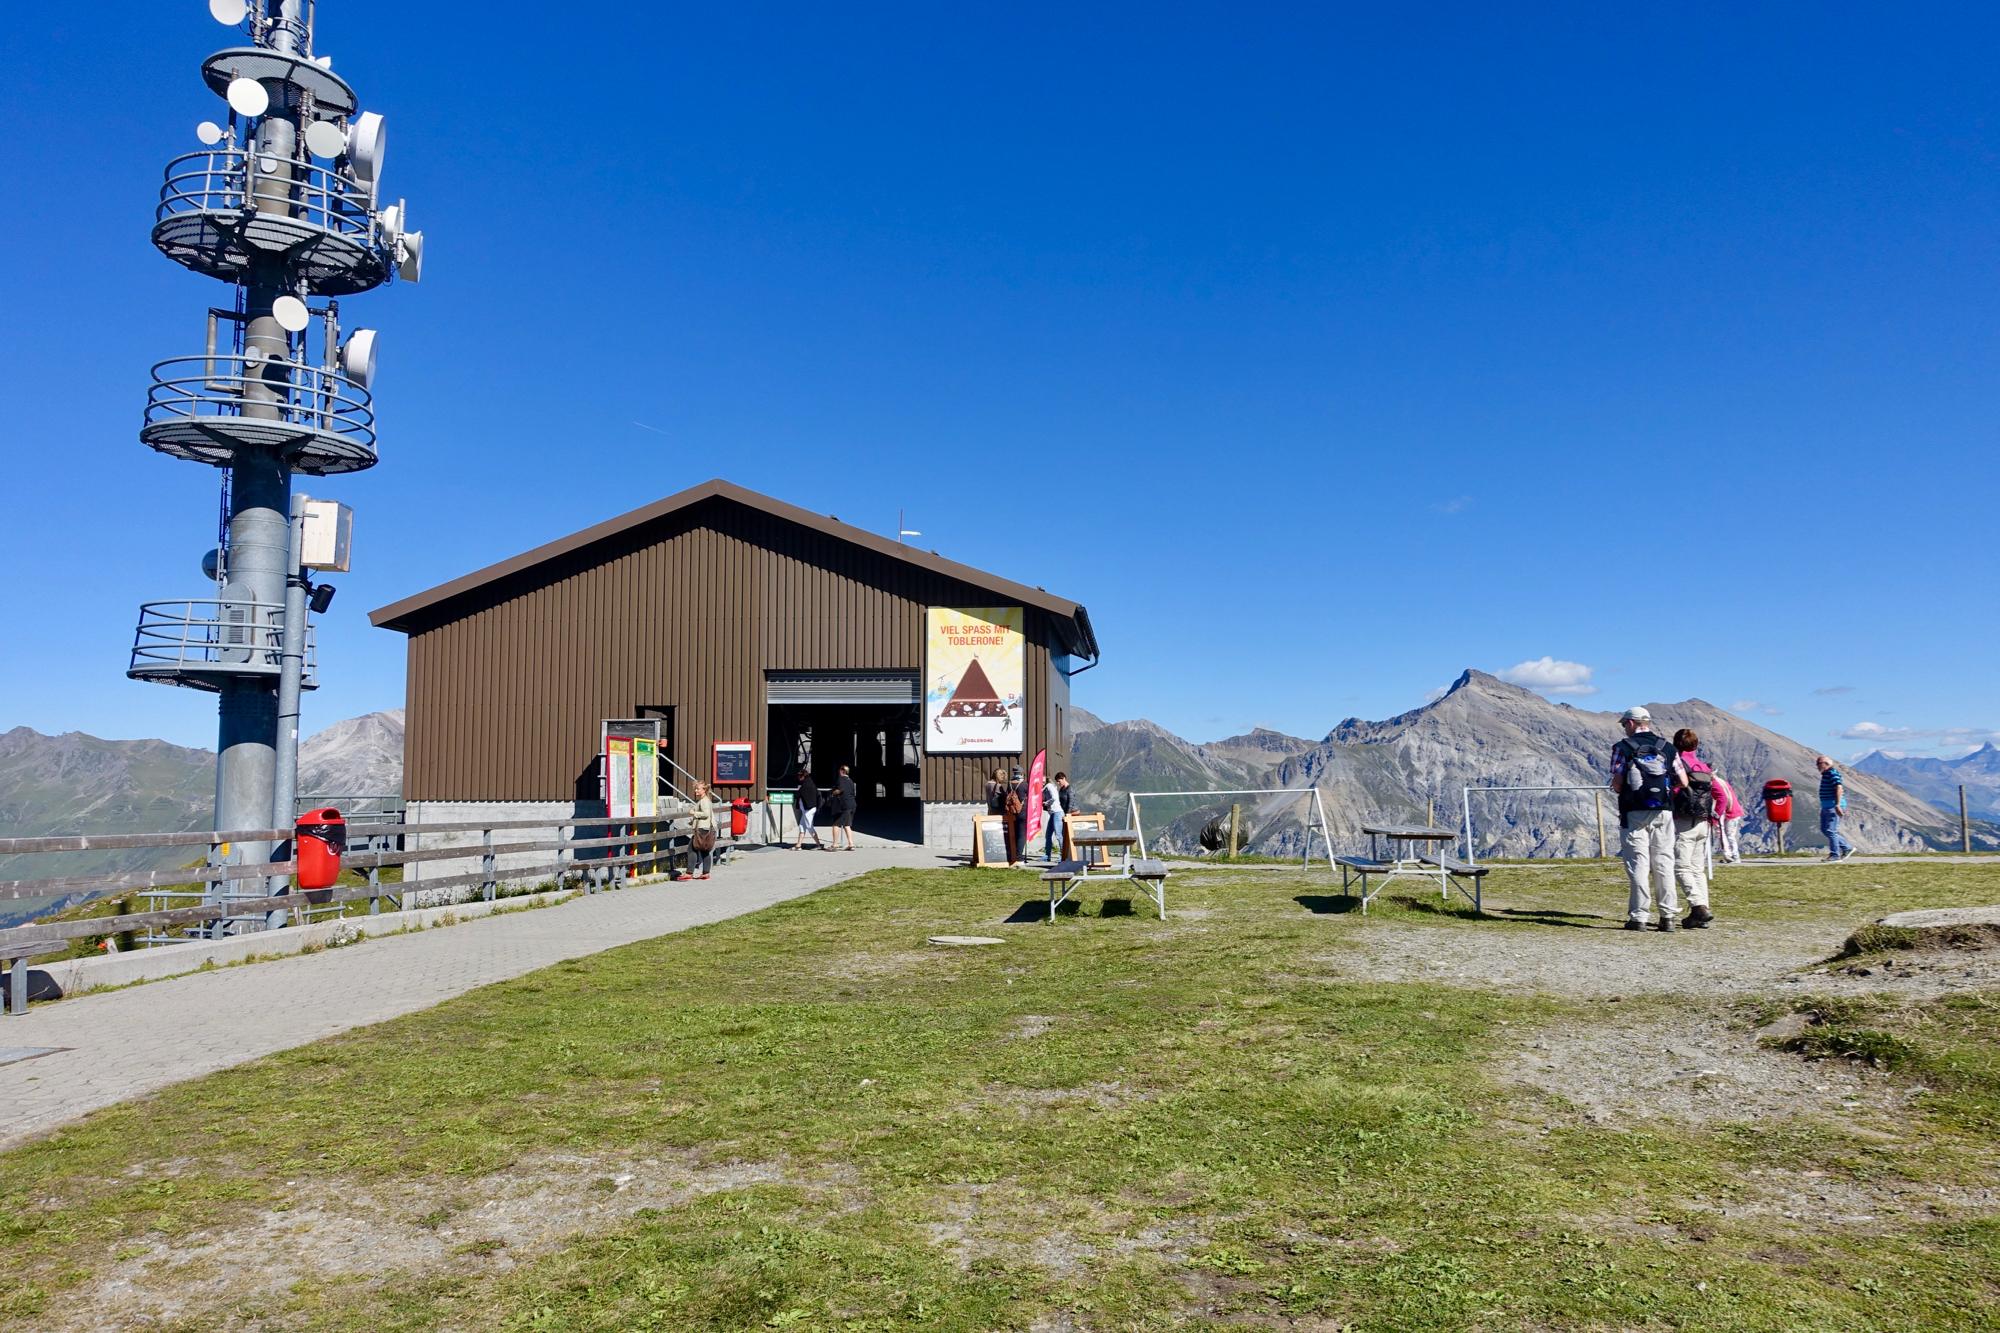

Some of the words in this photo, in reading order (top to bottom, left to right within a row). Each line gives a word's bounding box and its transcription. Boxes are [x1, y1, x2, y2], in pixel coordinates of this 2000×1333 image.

[940, 625, 960, 635] VIEL
[962, 625, 992, 635] SPASS
[994, 624, 1011, 634] MIT
[948, 636, 1004, 646] TOBLERONE!
